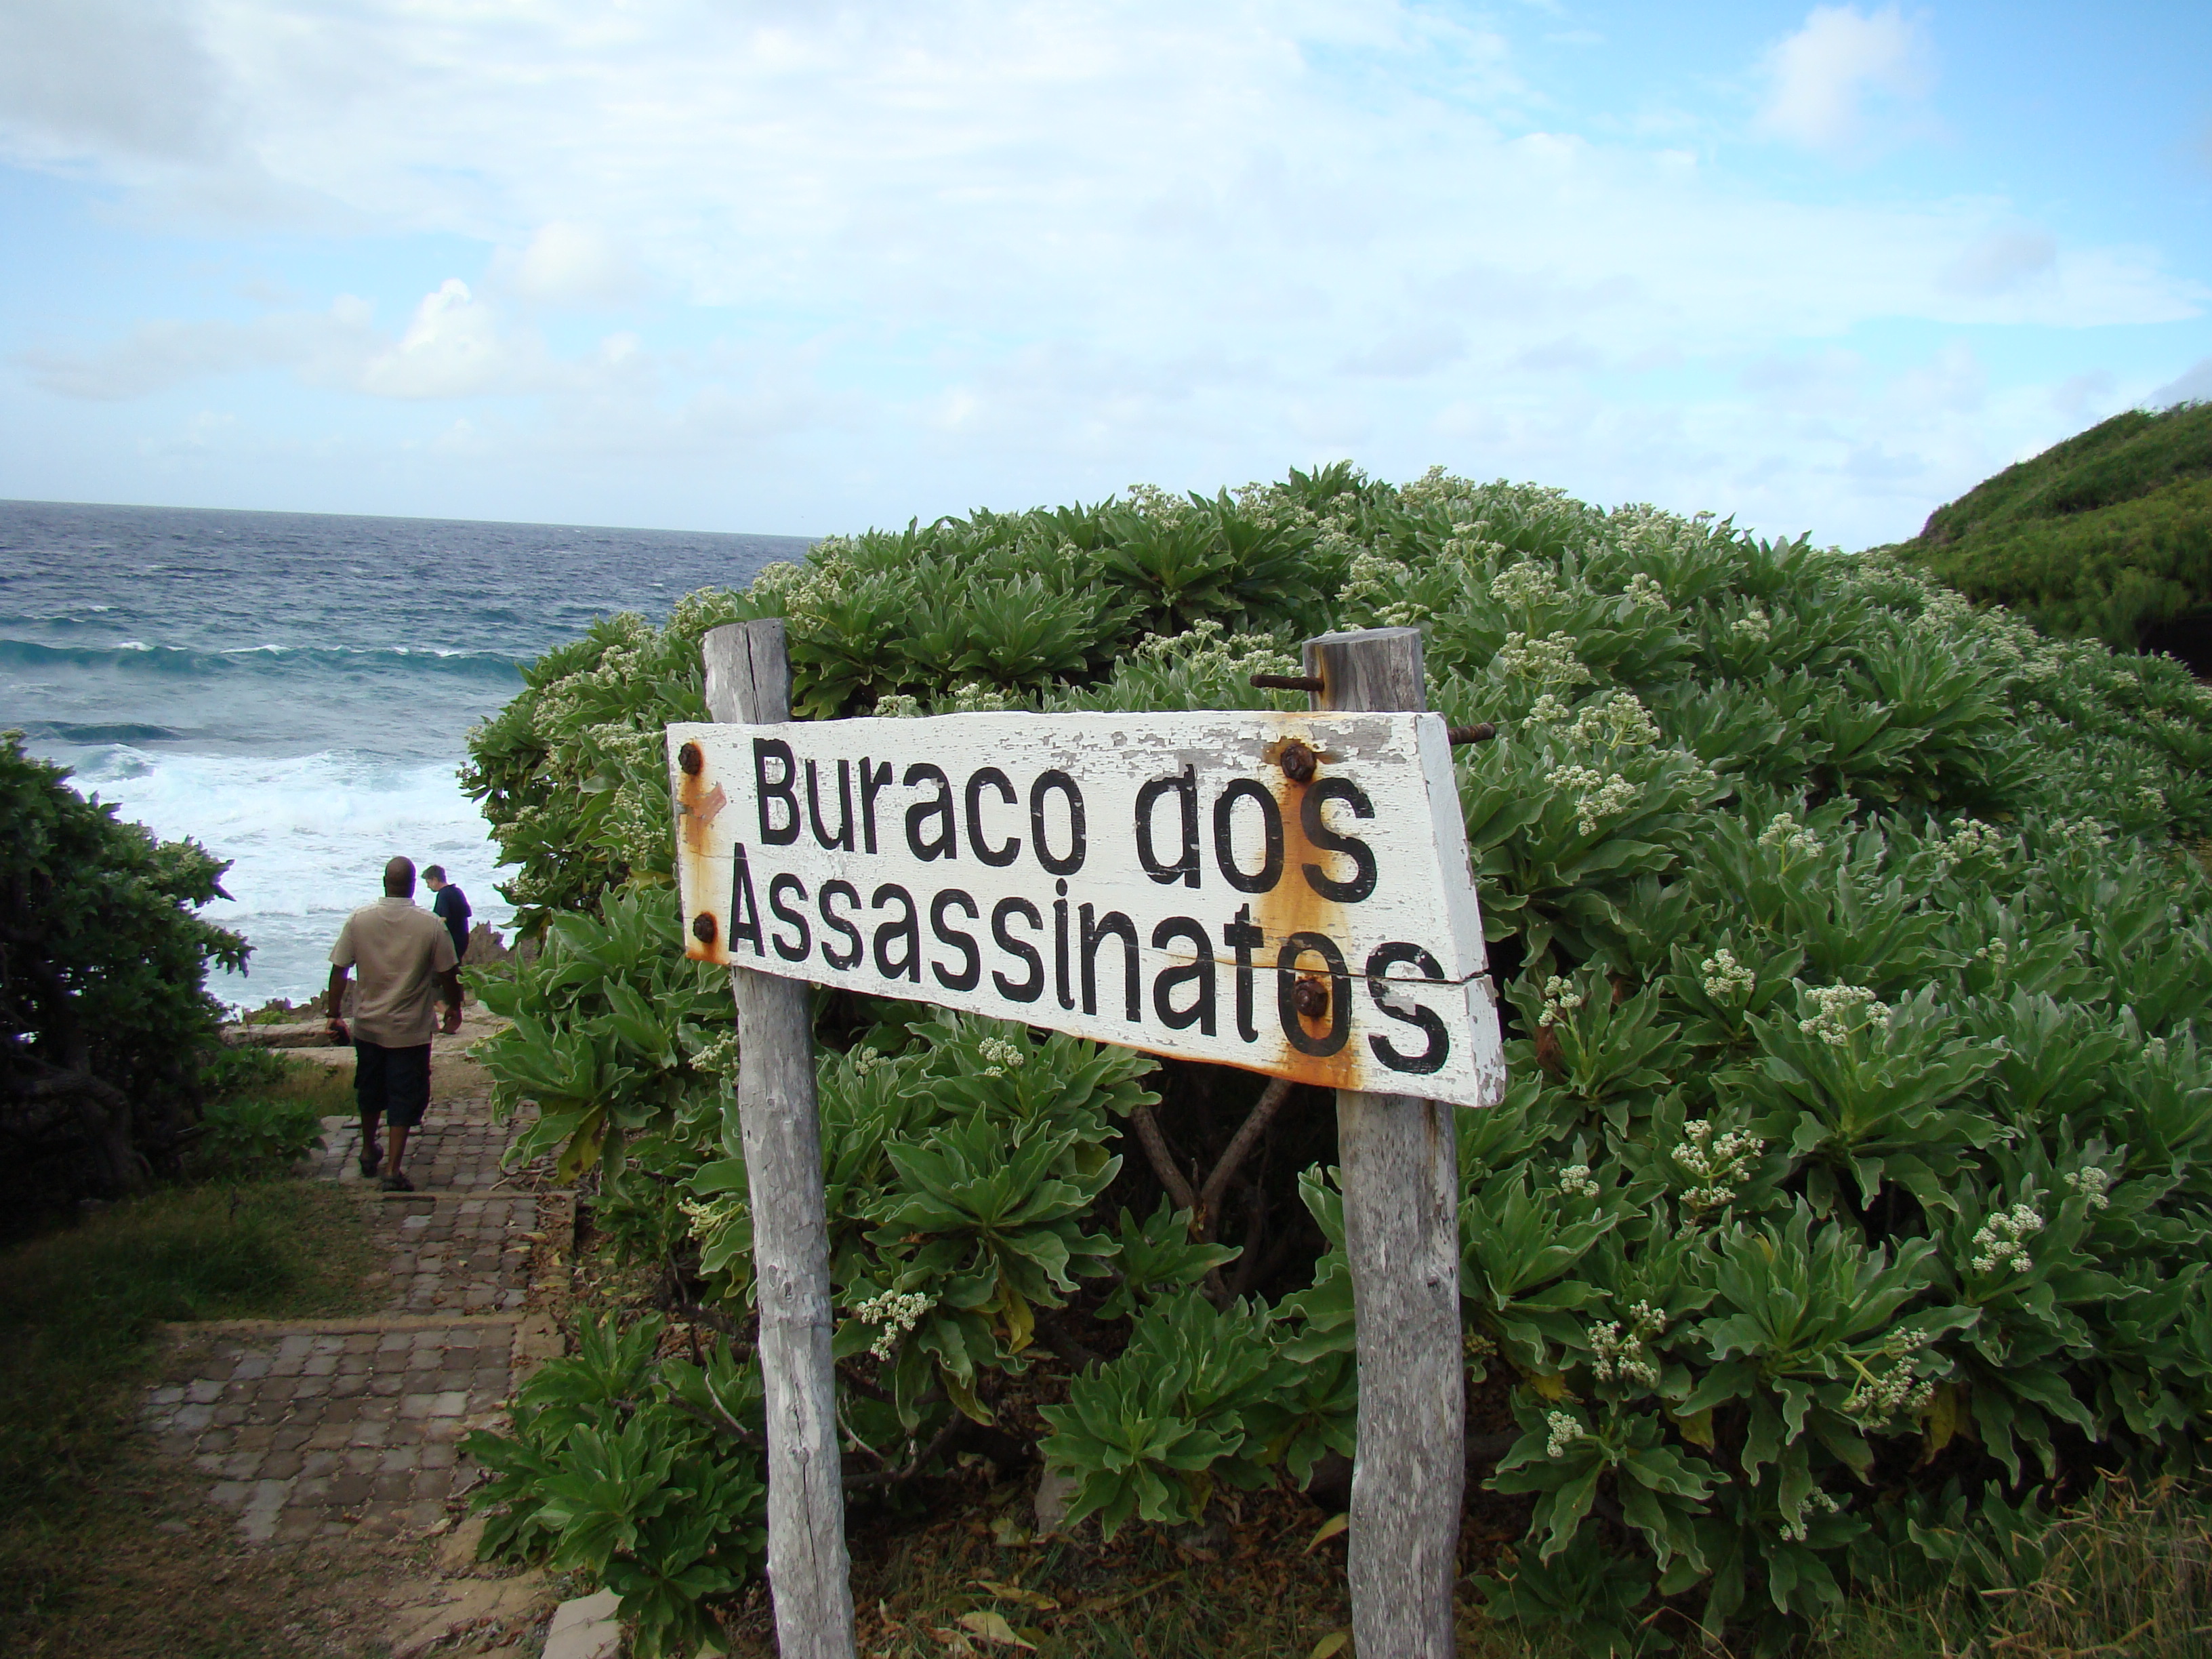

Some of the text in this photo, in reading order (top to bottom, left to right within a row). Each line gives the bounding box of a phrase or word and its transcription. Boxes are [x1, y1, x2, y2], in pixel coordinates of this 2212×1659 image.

[753, 737, 1377, 903] Buraco dos
[729, 842, 1450, 1074] Assassinatos
